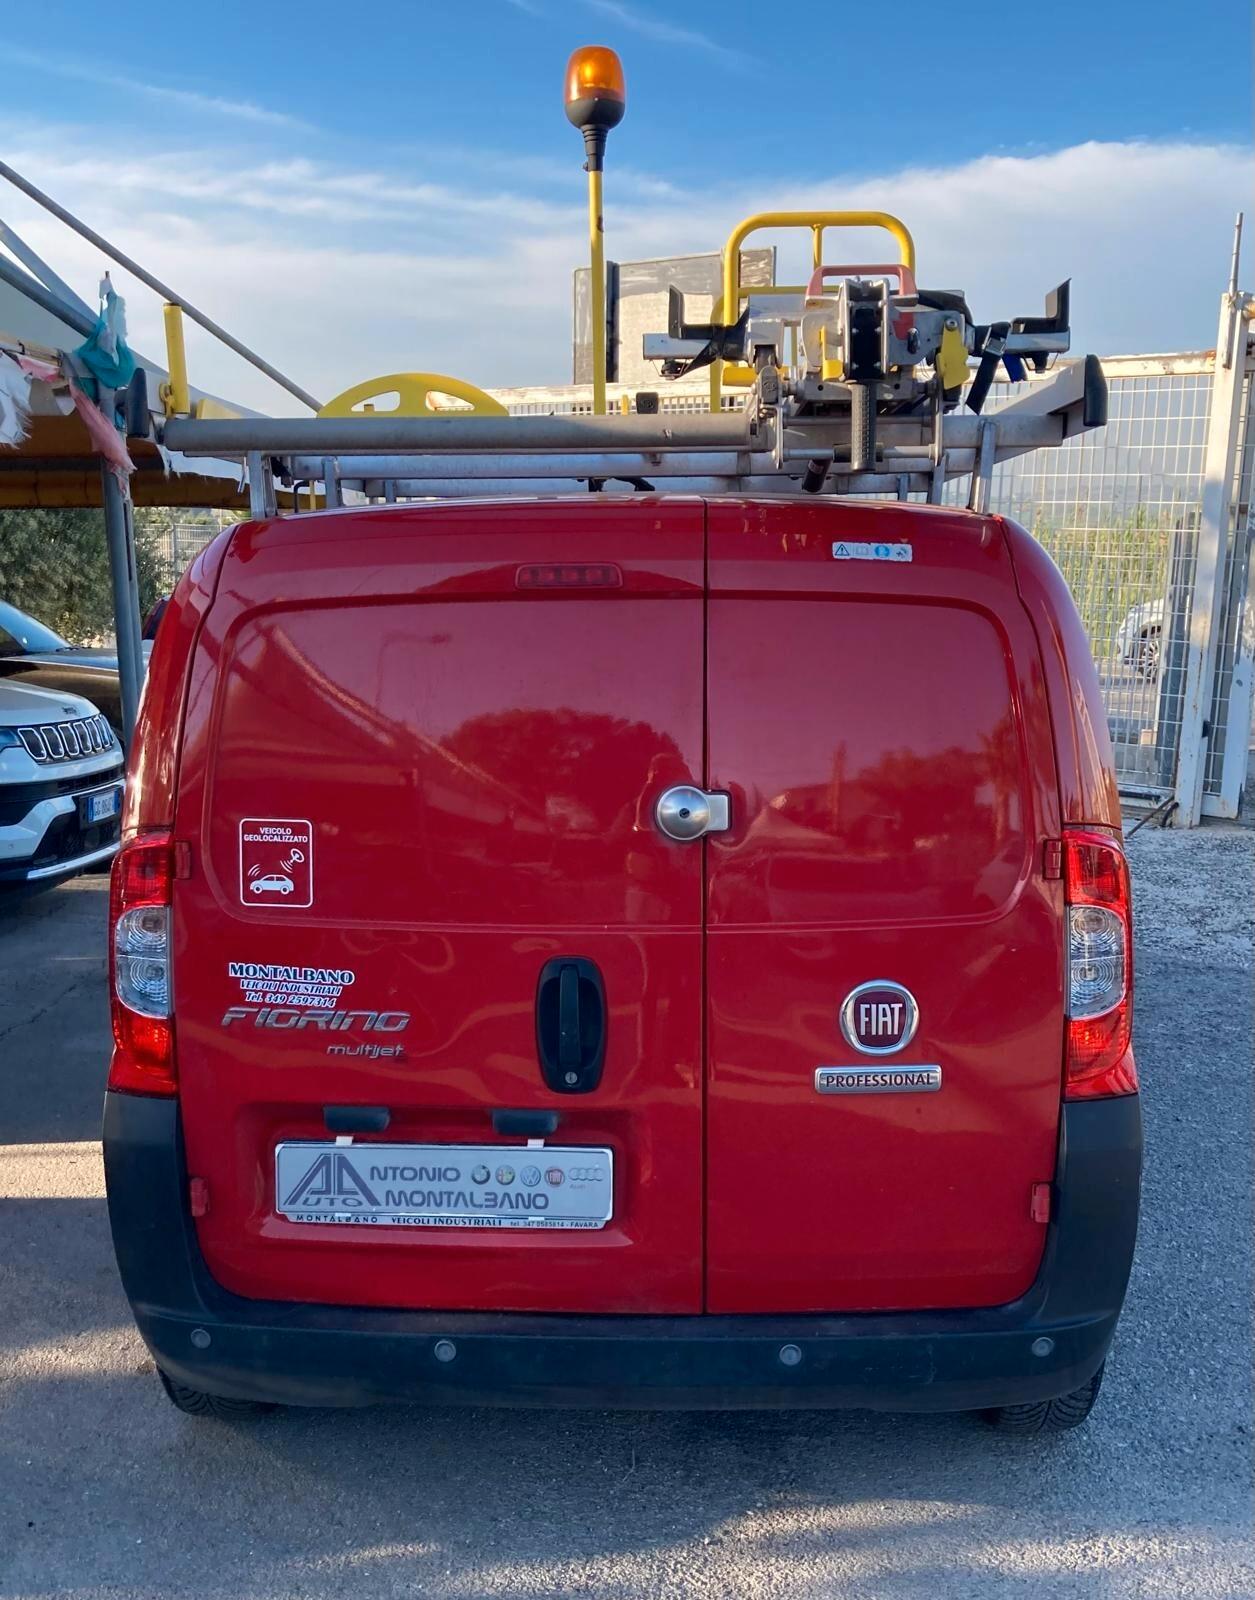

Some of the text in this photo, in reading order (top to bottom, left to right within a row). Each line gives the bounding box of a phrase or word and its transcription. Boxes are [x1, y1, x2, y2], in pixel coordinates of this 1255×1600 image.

[243, 834, 308, 843] GEOLOCALIZZATO
[259, 827, 292, 835] VEICOLO
[229, 962, 355, 985] MONTALBANO
[240, 979, 342, 996] VEICOLI INDUSTRIALI
[245, 992, 263, 1002] Tel.
[265, 994, 286, 1005] 349
[860, 1003, 903, 1036] FIAT
[326, 1044, 404, 1059] multijet
[825, 1073, 934, 1088] PROFESSIONAL
[385, 1189, 549, 1210] MONTALBANO
[296, 1214, 378, 1224] MONTALBANO
[391, 1216, 430, 1225] VEICOLI
[433, 1217, 502, 1227] INDUSTRIALI
